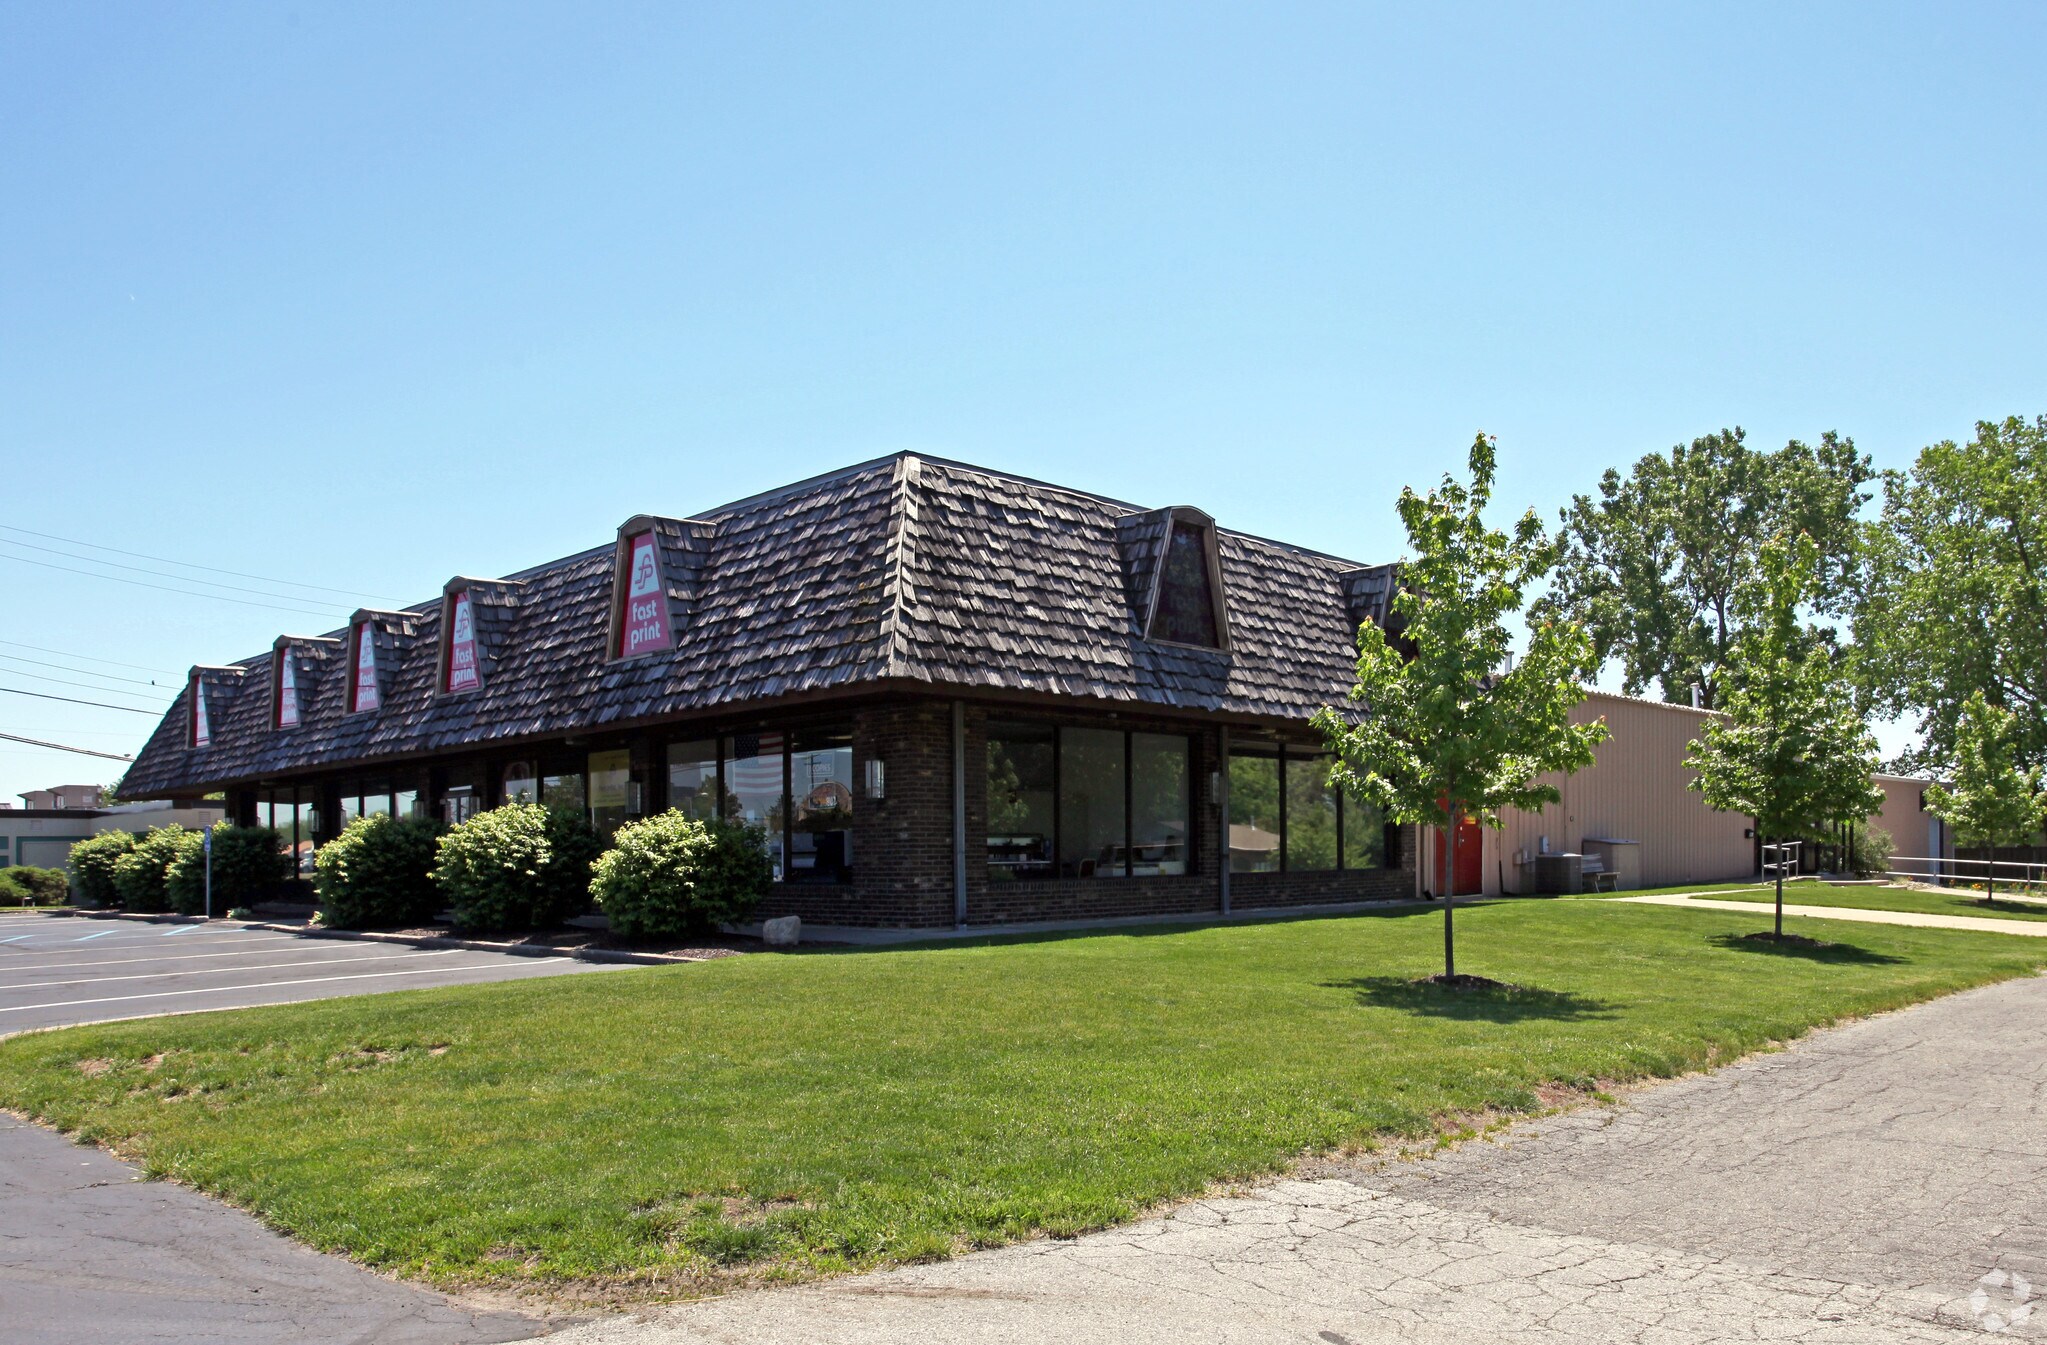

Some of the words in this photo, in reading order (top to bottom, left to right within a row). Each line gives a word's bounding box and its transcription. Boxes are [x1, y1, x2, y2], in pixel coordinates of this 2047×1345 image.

[632, 600, 657, 622] fast
[631, 621, 660, 650] print
[455, 647, 473, 664] fast
[454, 665, 476, 687] print
